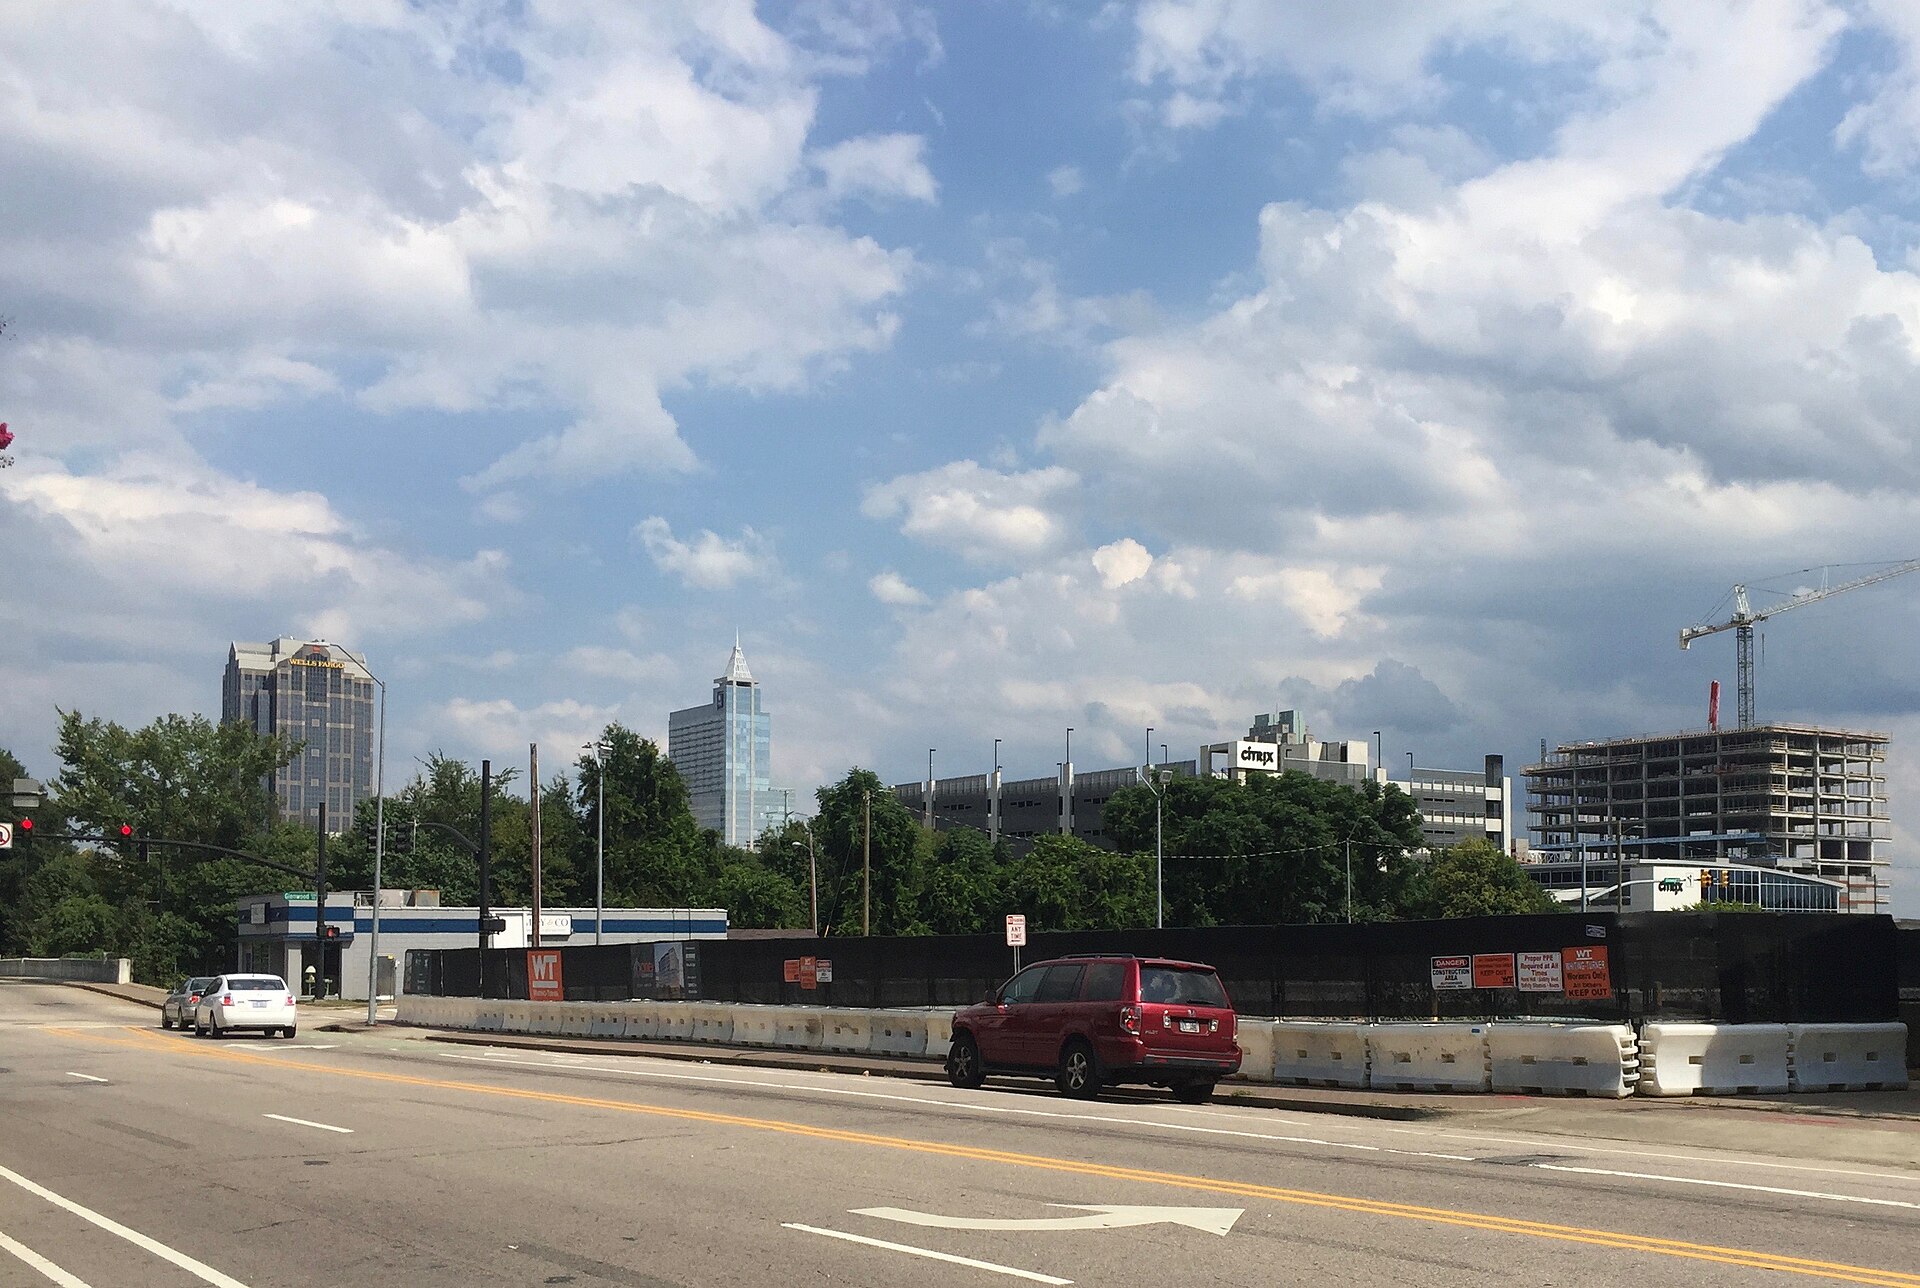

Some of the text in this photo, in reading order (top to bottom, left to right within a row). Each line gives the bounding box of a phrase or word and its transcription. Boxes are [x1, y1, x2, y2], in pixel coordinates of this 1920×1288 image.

[289, 659, 345, 669] WELLS FARGO
[1576, 950, 1592, 958] WT
[532, 954, 558, 980] WT
[1592, 971, 1606, 980] Only
